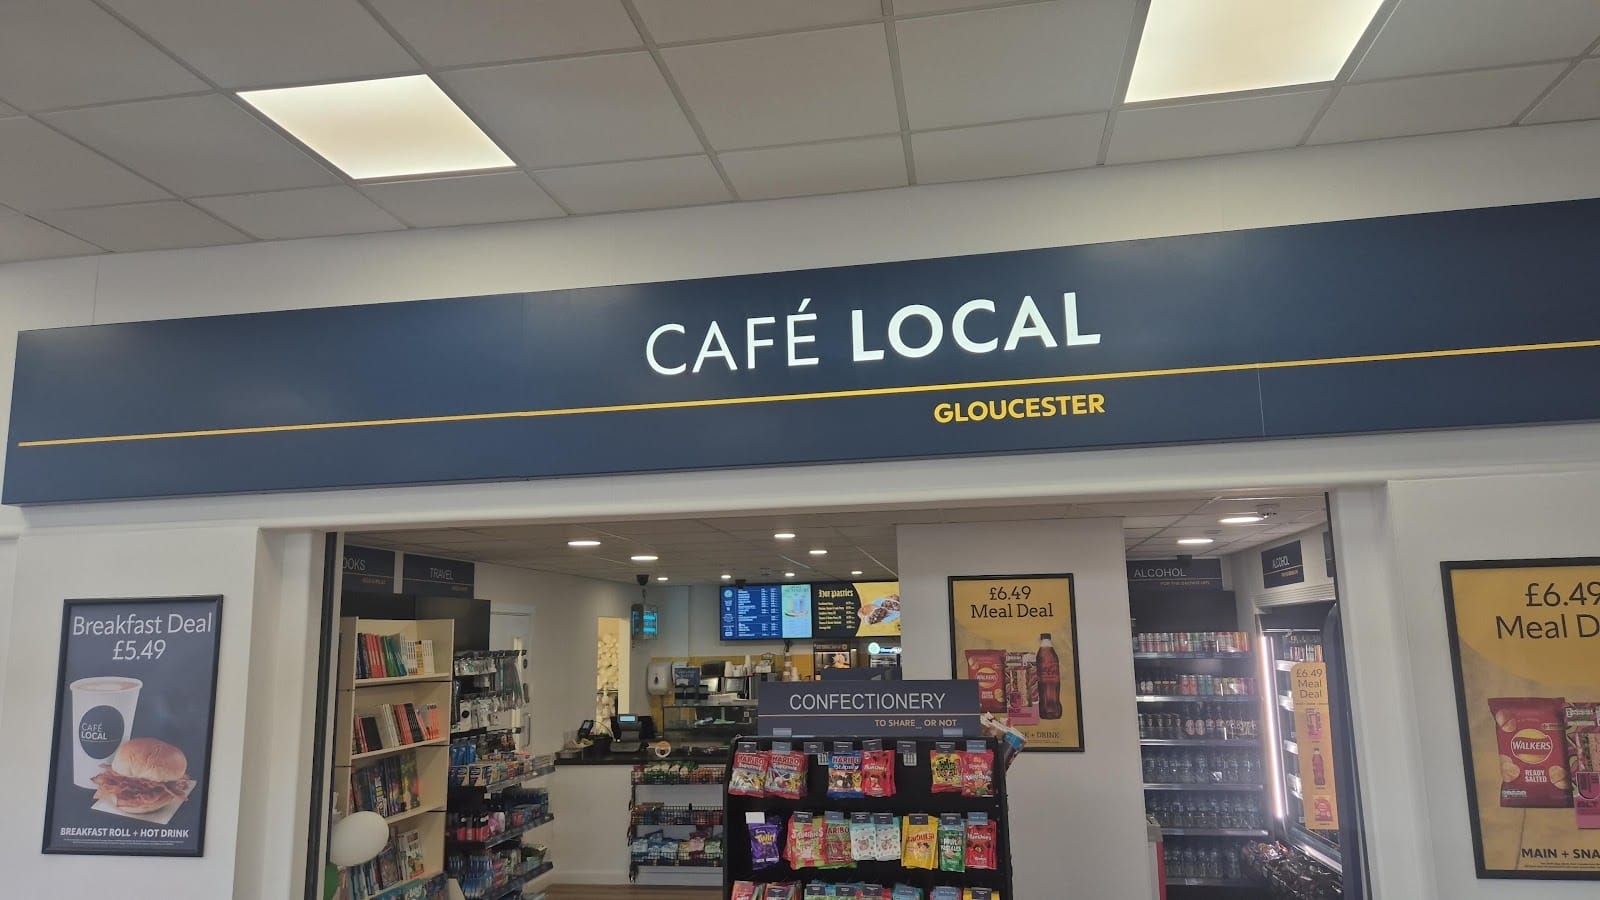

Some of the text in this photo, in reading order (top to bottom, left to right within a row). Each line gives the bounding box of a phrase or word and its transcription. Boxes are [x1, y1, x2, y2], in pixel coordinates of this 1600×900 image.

[646, 292, 1102, 376] CAFÉ LOCAL
[934, 393, 1106, 424] GLOUCESTER
[430, 567, 455, 581] TRAVEL
[1133, 567, 1187, 578] ALCOHOL
[990, 585, 1032, 601] £6.49
[1524, 581, 1600, 607] £6.49
[971, 603, 1054, 619] Meal Deal
[72, 611, 213, 636] Breakfast Deal
[1495, 613, 1567, 640] Meal
[112, 639, 167, 662] £5.49
[1298, 679, 1322, 689] Meal
[1299, 689, 1322, 699] Deal
[789, 692, 946, 711] CONFECTIONERY
[874, 719, 886, 727] TO
[924, 719, 937, 728] OR
[939, 719, 958, 728] NOT
[80, 731, 108, 741] LOCAL
[1511, 740, 1551, 751] WALKERS
[1525, 769, 1545, 777] READY
[1525, 775, 1548, 783] SALTED
[59, 827, 106, 837] BREAKFAST
[108, 828, 132, 838] ROLL
[140, 829, 160, 838] HOT
[161, 829, 190, 839] DRINK
[1521, 847, 1558, 859] MAIN
[1561, 850, 1569, 859] +
